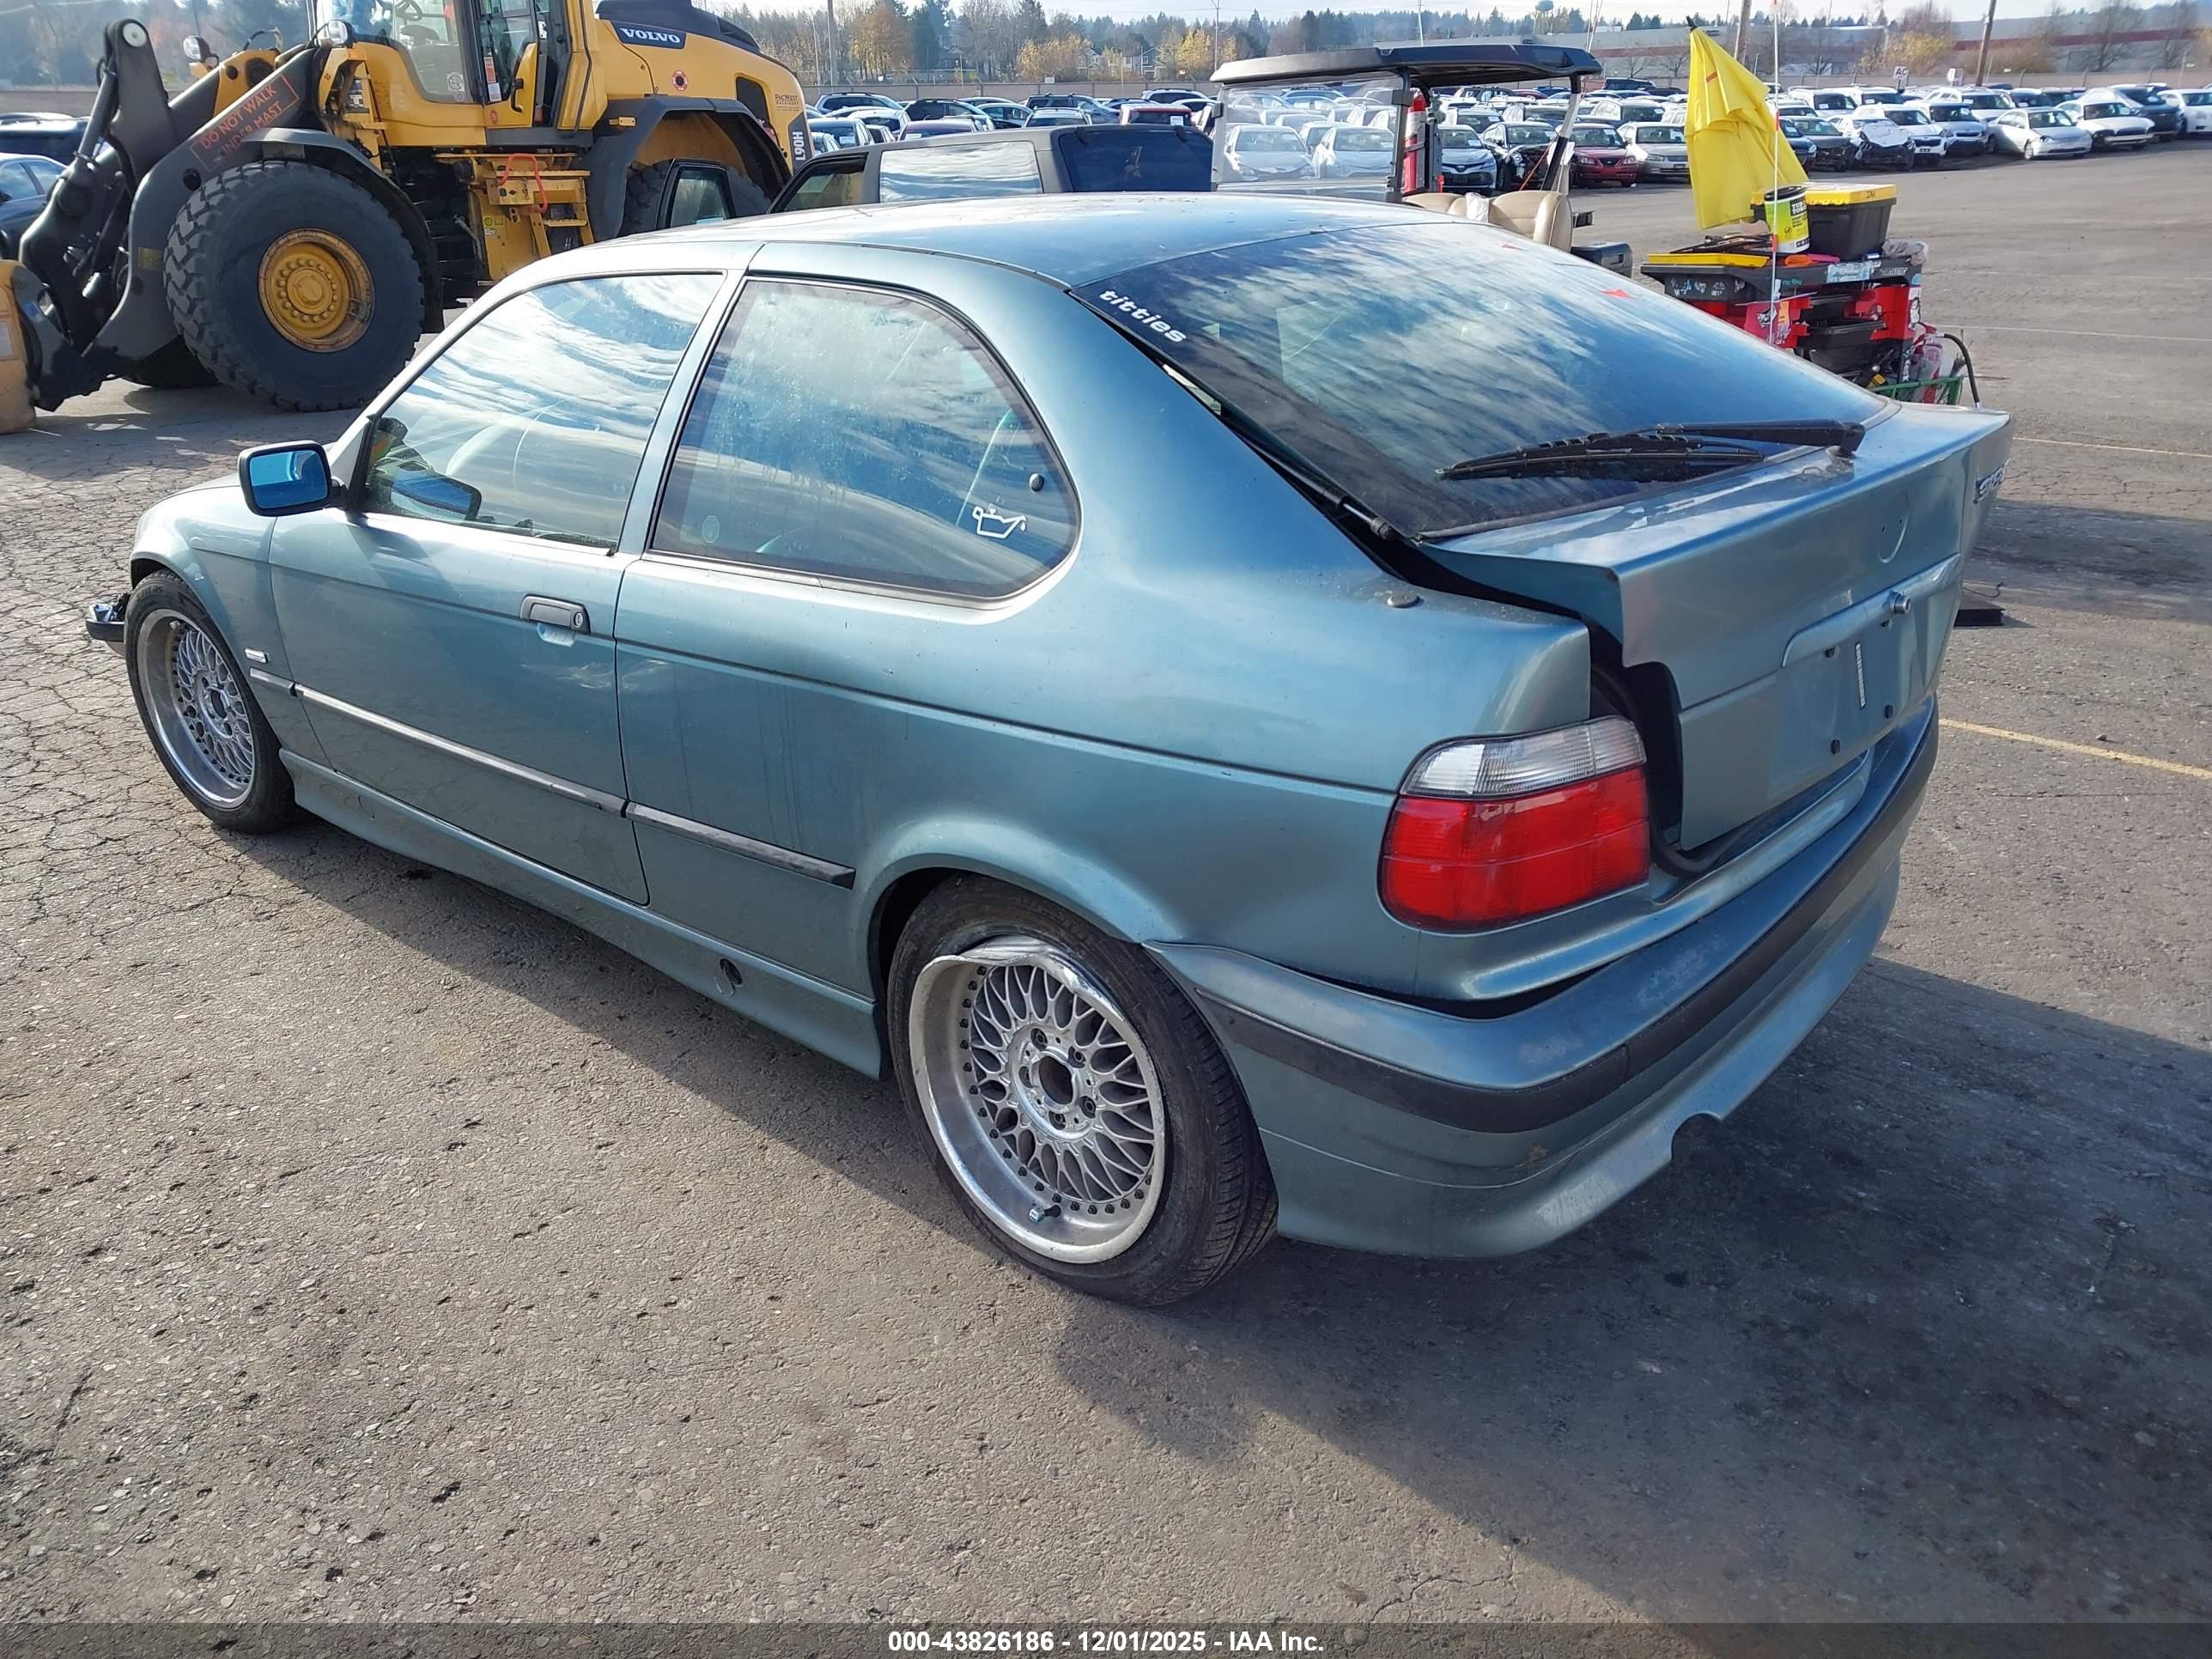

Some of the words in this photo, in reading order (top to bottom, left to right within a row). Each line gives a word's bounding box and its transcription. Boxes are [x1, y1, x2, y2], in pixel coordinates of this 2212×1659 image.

[619, 27, 681, 43] VOLVO
[200, 131, 220, 150] DO
[219, 108, 245, 135] NOT
[243, 85, 277, 114] WALK
[253, 100, 283, 129] MAST
[792, 131, 806, 161] L90H
[1099, 290, 1187, 343] titties
